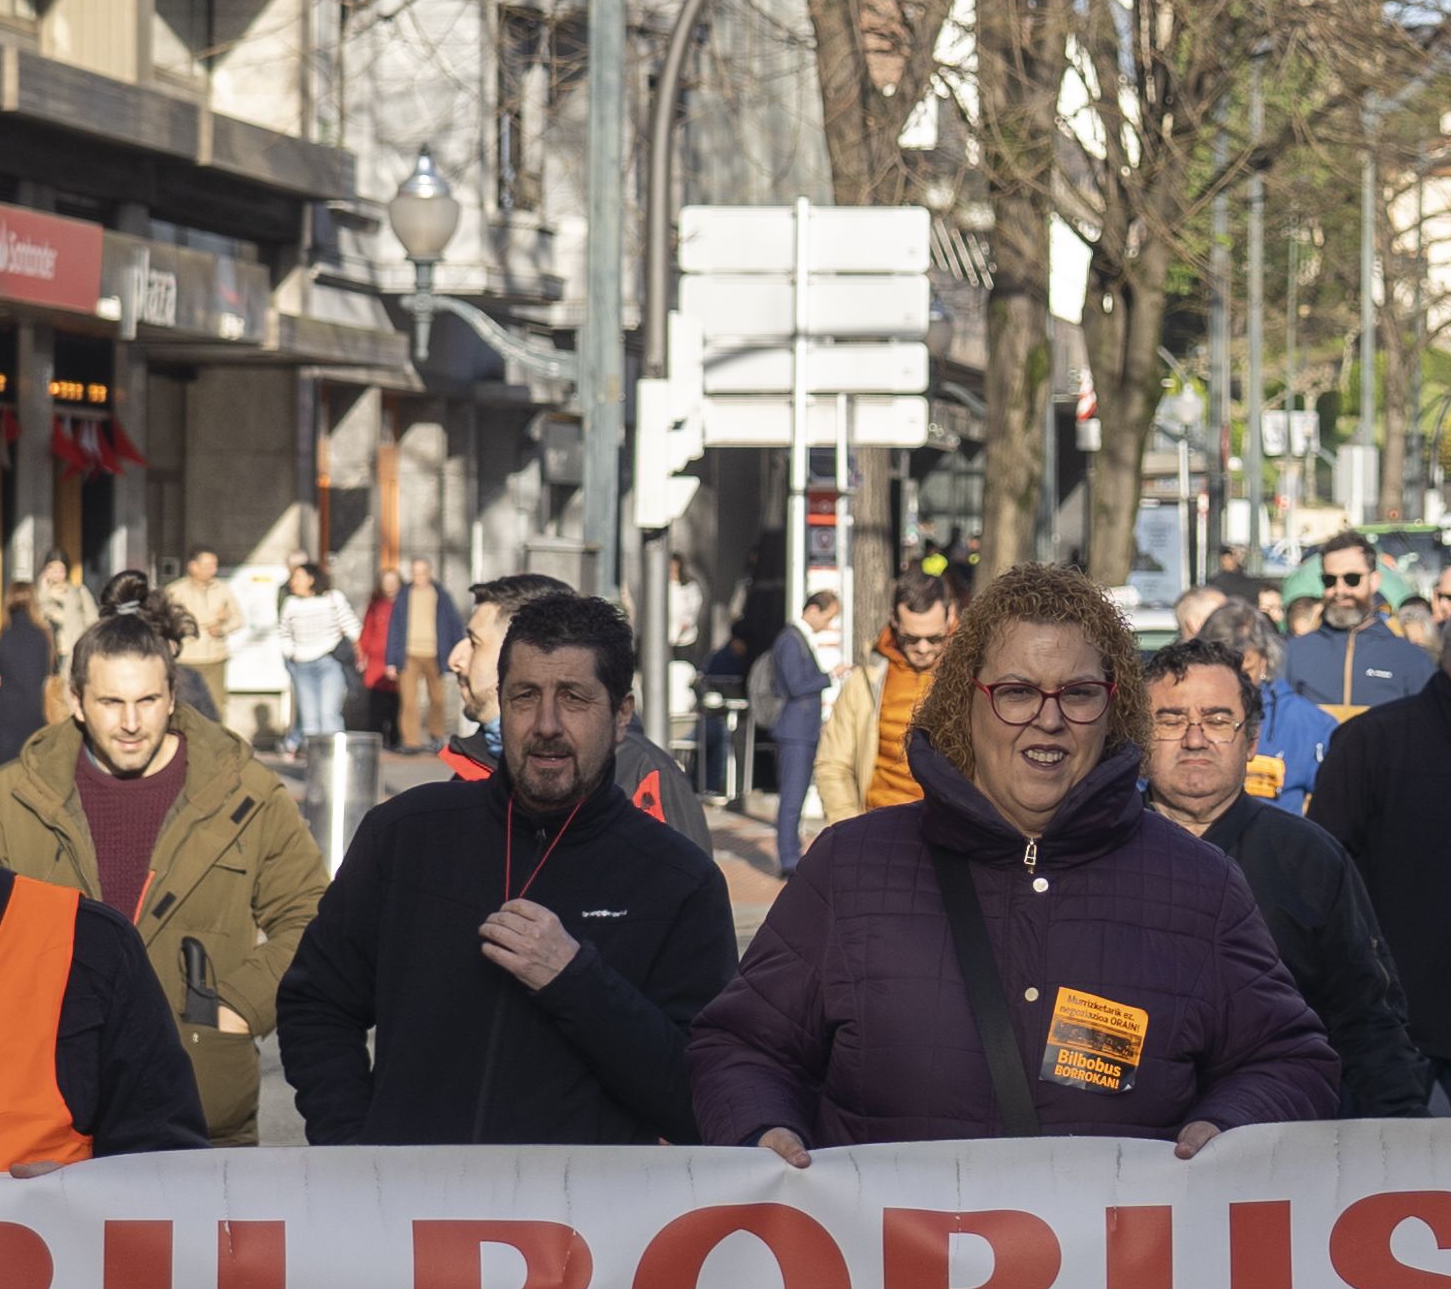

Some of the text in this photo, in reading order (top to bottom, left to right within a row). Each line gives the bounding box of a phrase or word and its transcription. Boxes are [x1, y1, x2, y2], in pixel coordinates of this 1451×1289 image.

[1068, 994, 1123, 1017] Murrizketarik
[1110, 1016, 1141, 1033] ORAIN!
[1058, 1048, 1122, 1077] Bilbobus
[1054, 1064, 1120, 1089] BORROKAN!
